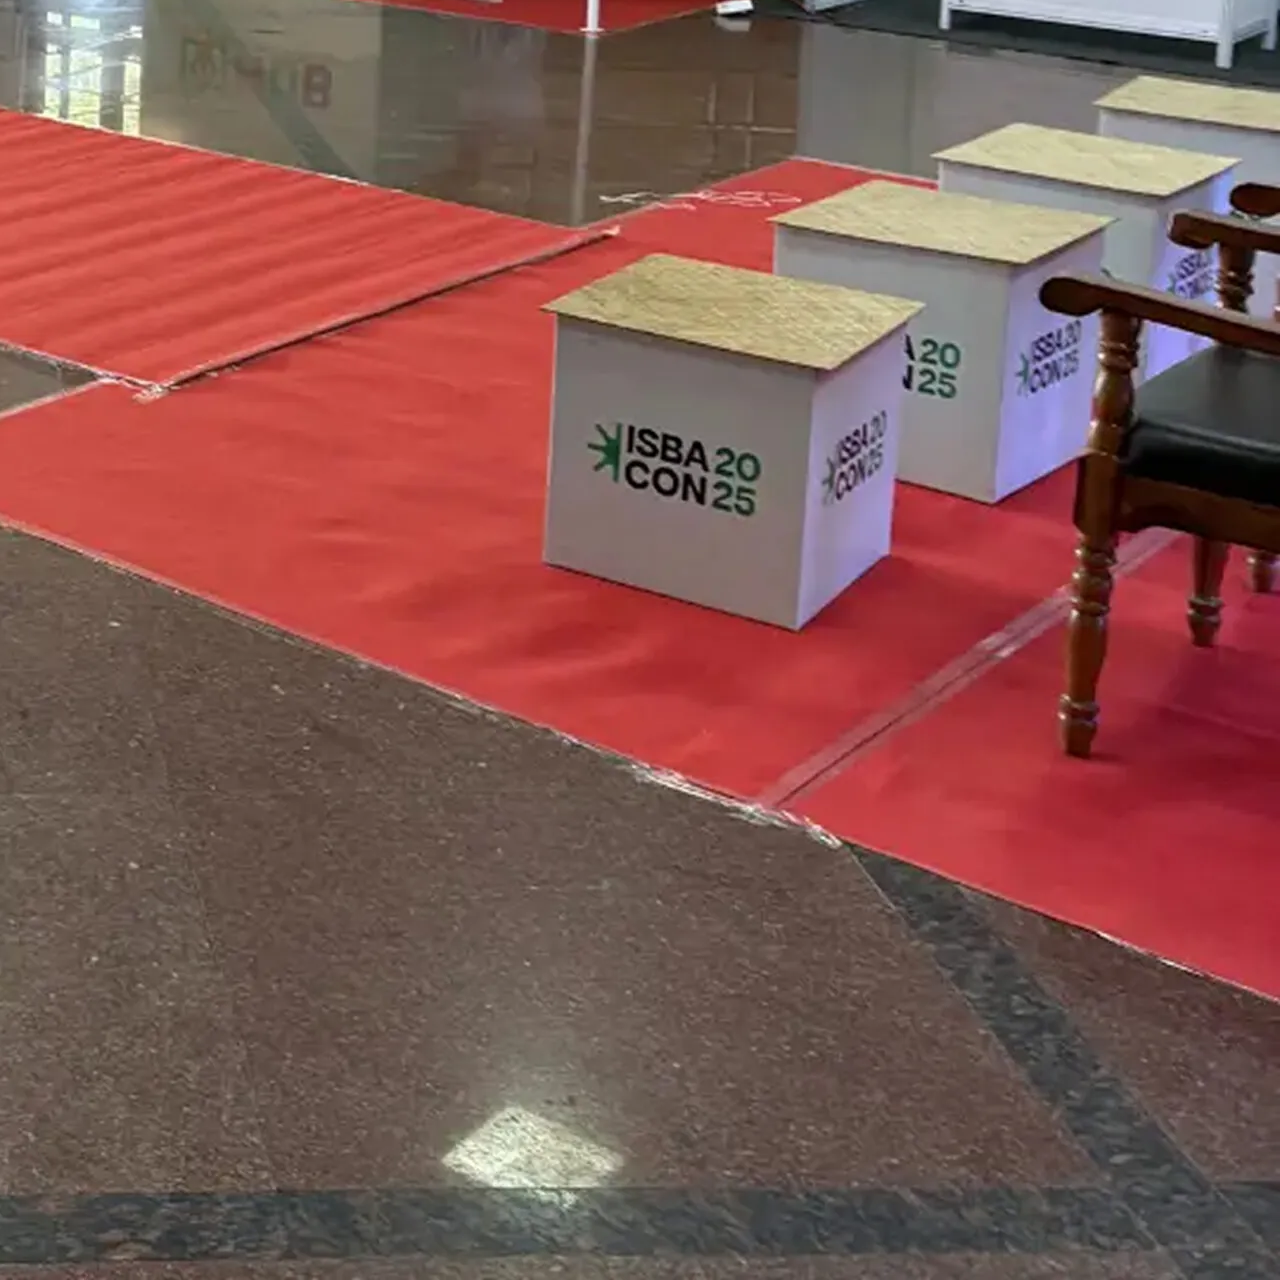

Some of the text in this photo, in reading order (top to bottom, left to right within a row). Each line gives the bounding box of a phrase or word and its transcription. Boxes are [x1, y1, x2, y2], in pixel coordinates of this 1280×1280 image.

[919, 337, 962, 369] 20
[917, 368, 957, 399] 25
[626, 424, 761, 483] ISBA 20
[624, 460, 757, 516] CON 25
